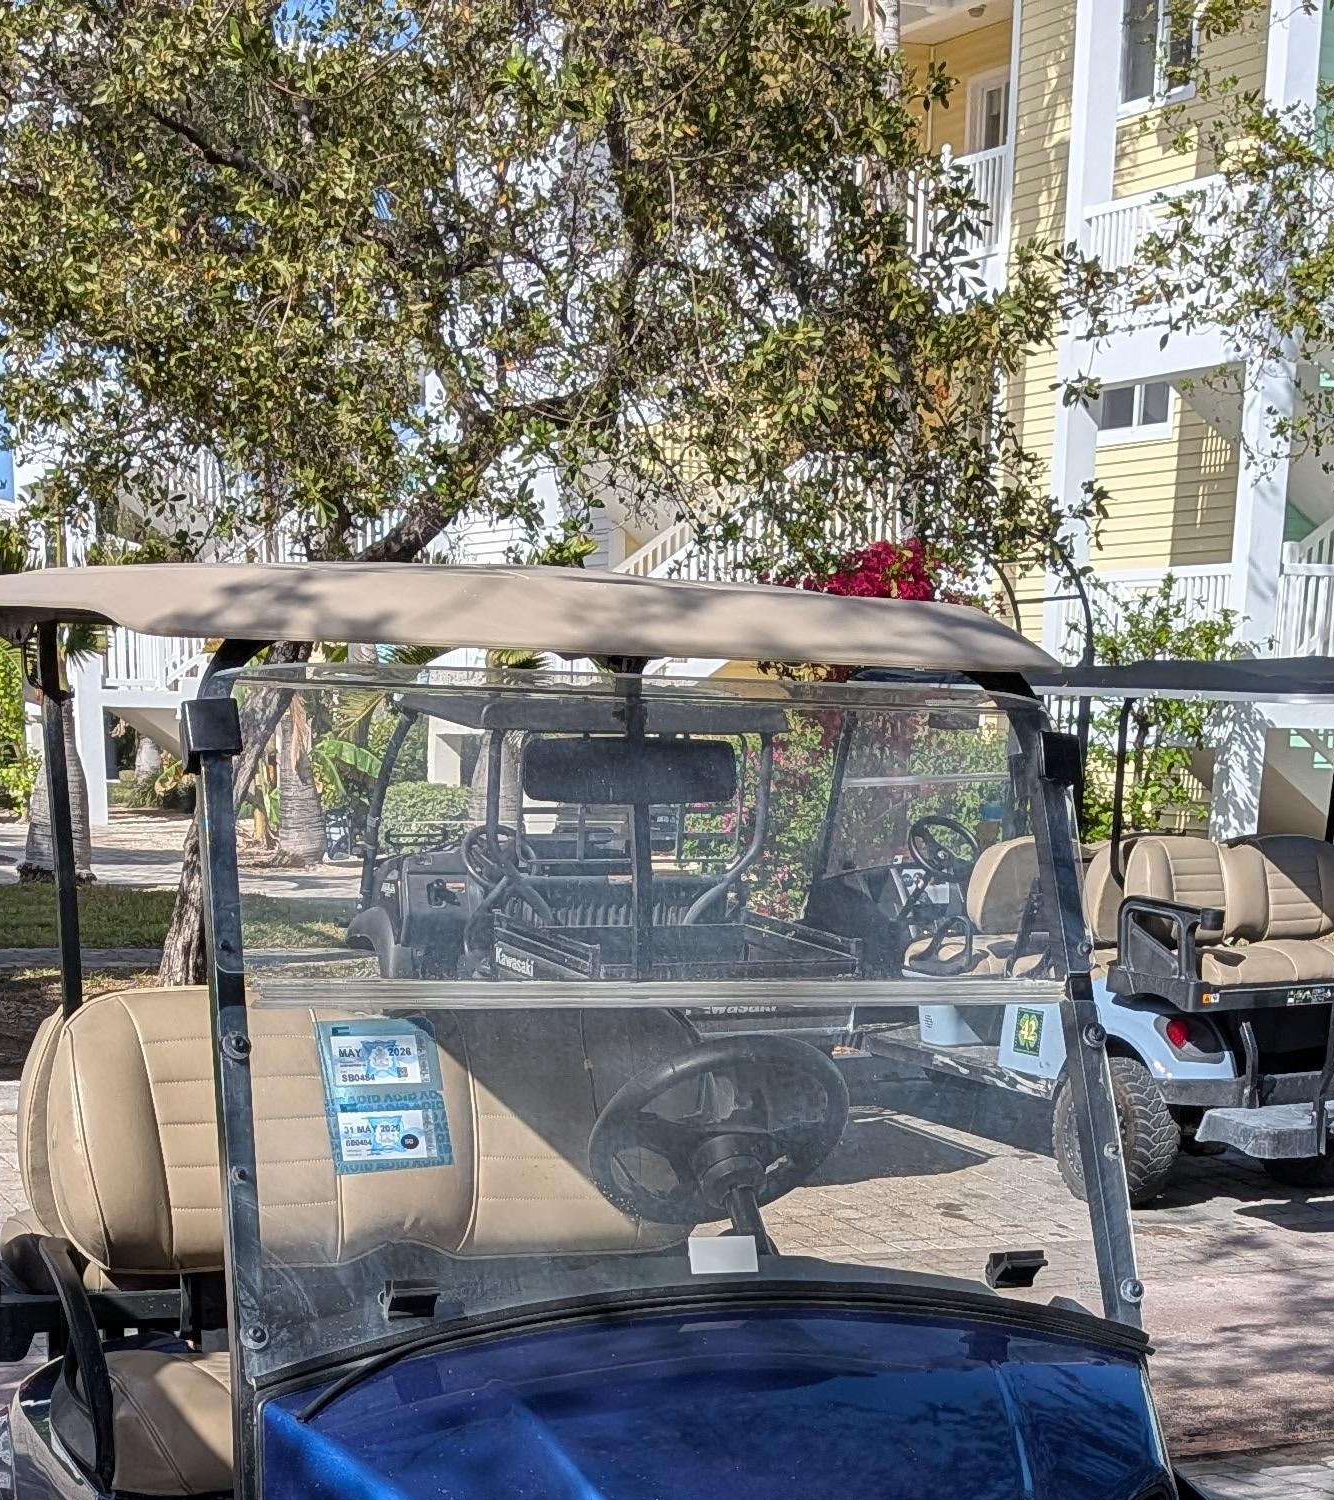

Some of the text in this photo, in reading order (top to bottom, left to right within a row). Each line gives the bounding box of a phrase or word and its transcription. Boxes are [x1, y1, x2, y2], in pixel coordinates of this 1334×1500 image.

[495, 946, 534, 977] Kawasaki
[1019, 1020, 1037, 1041] 42
[339, 1048, 362, 1057] MAY
[344, 1126, 353, 1134] 31
[357, 1125, 376, 1133] MAY
